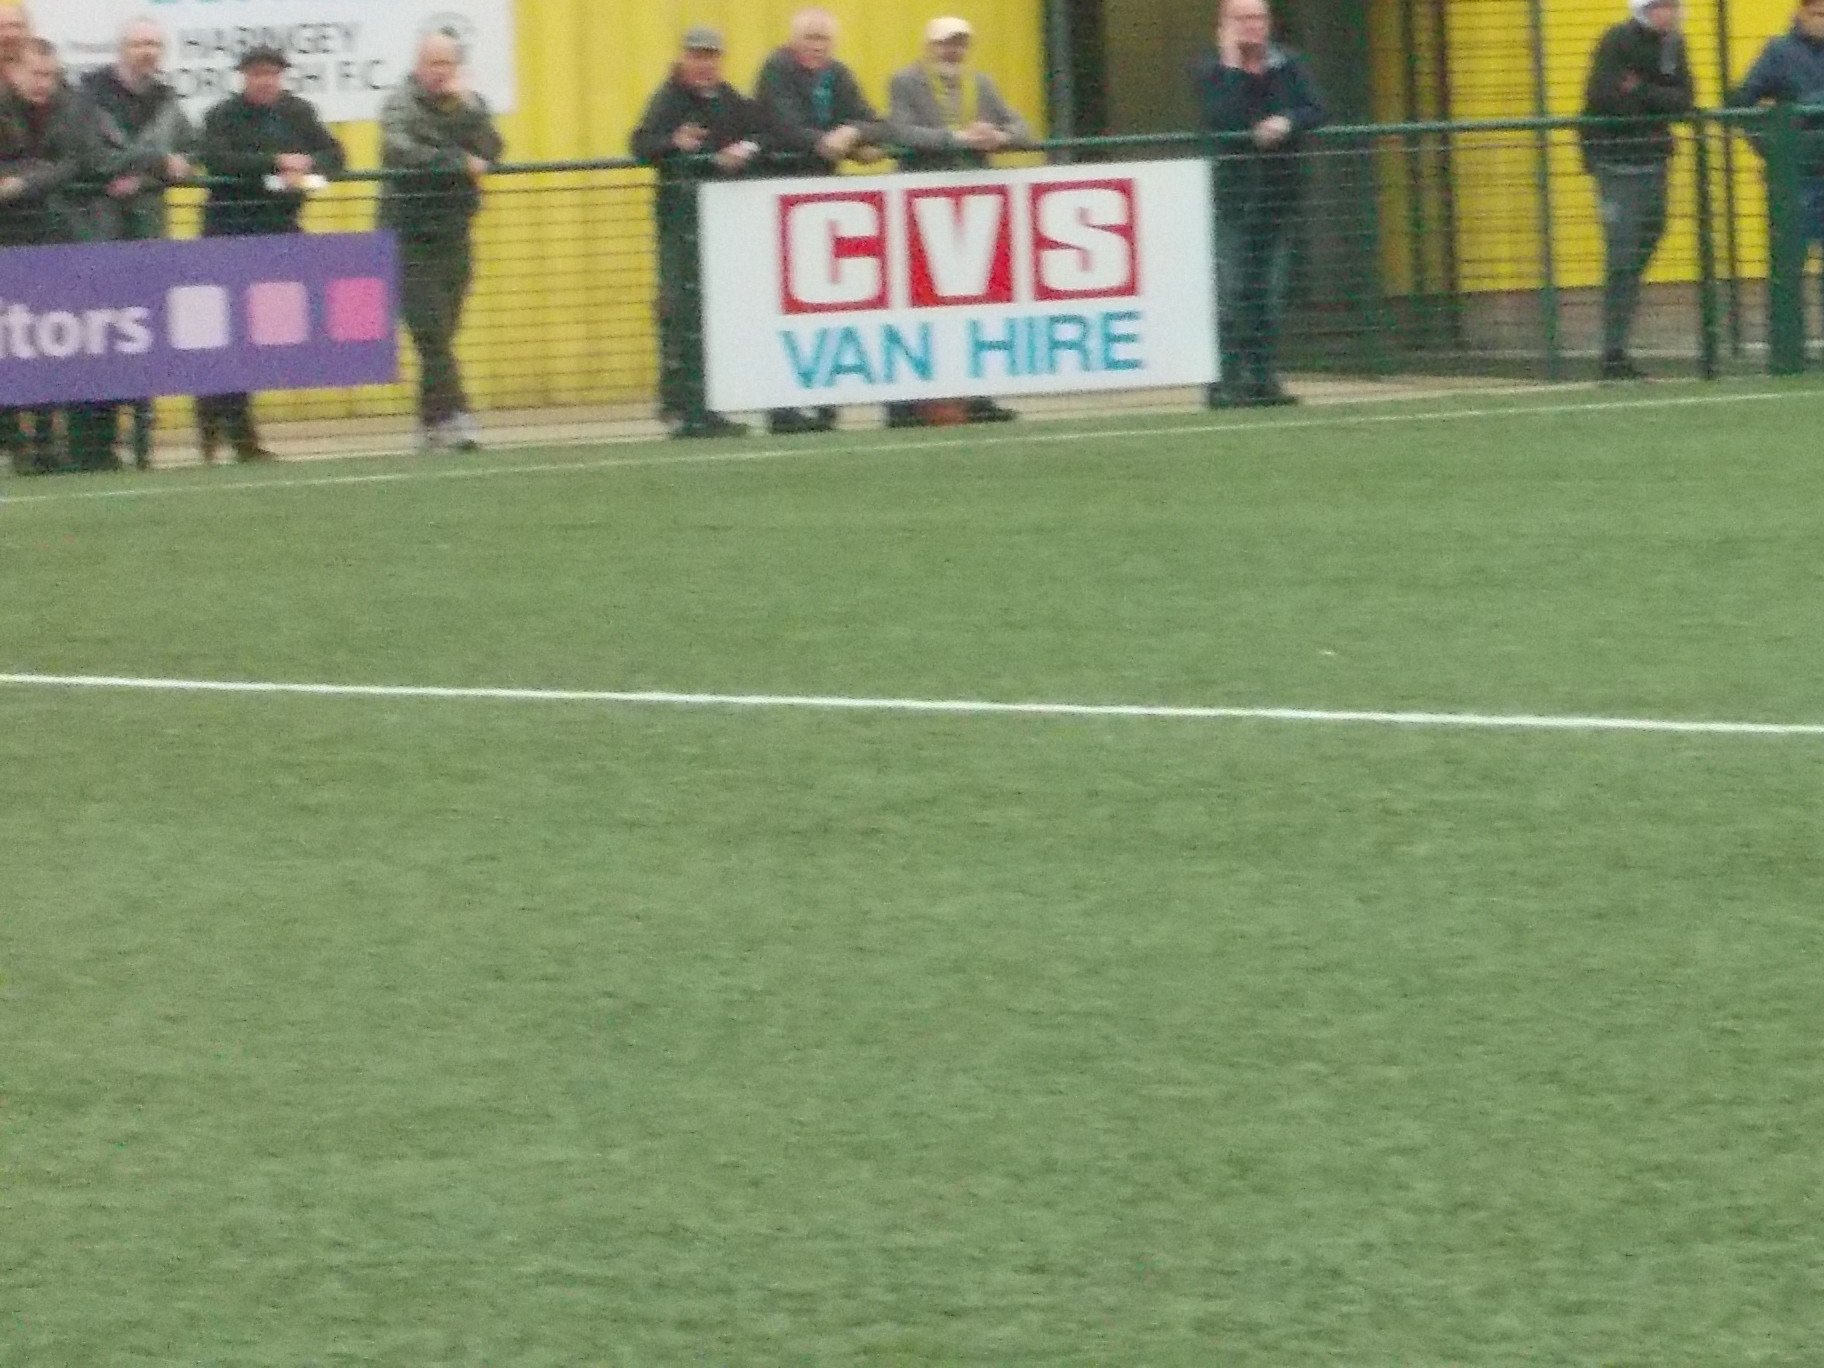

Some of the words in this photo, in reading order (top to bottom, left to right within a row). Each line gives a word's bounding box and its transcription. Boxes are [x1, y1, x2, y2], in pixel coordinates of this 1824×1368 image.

[779, 179, 1139, 314] CVS
[0, 296, 152, 359] tors
[779, 322, 936, 389] VAN
[968, 311, 1145, 379] HIRE
